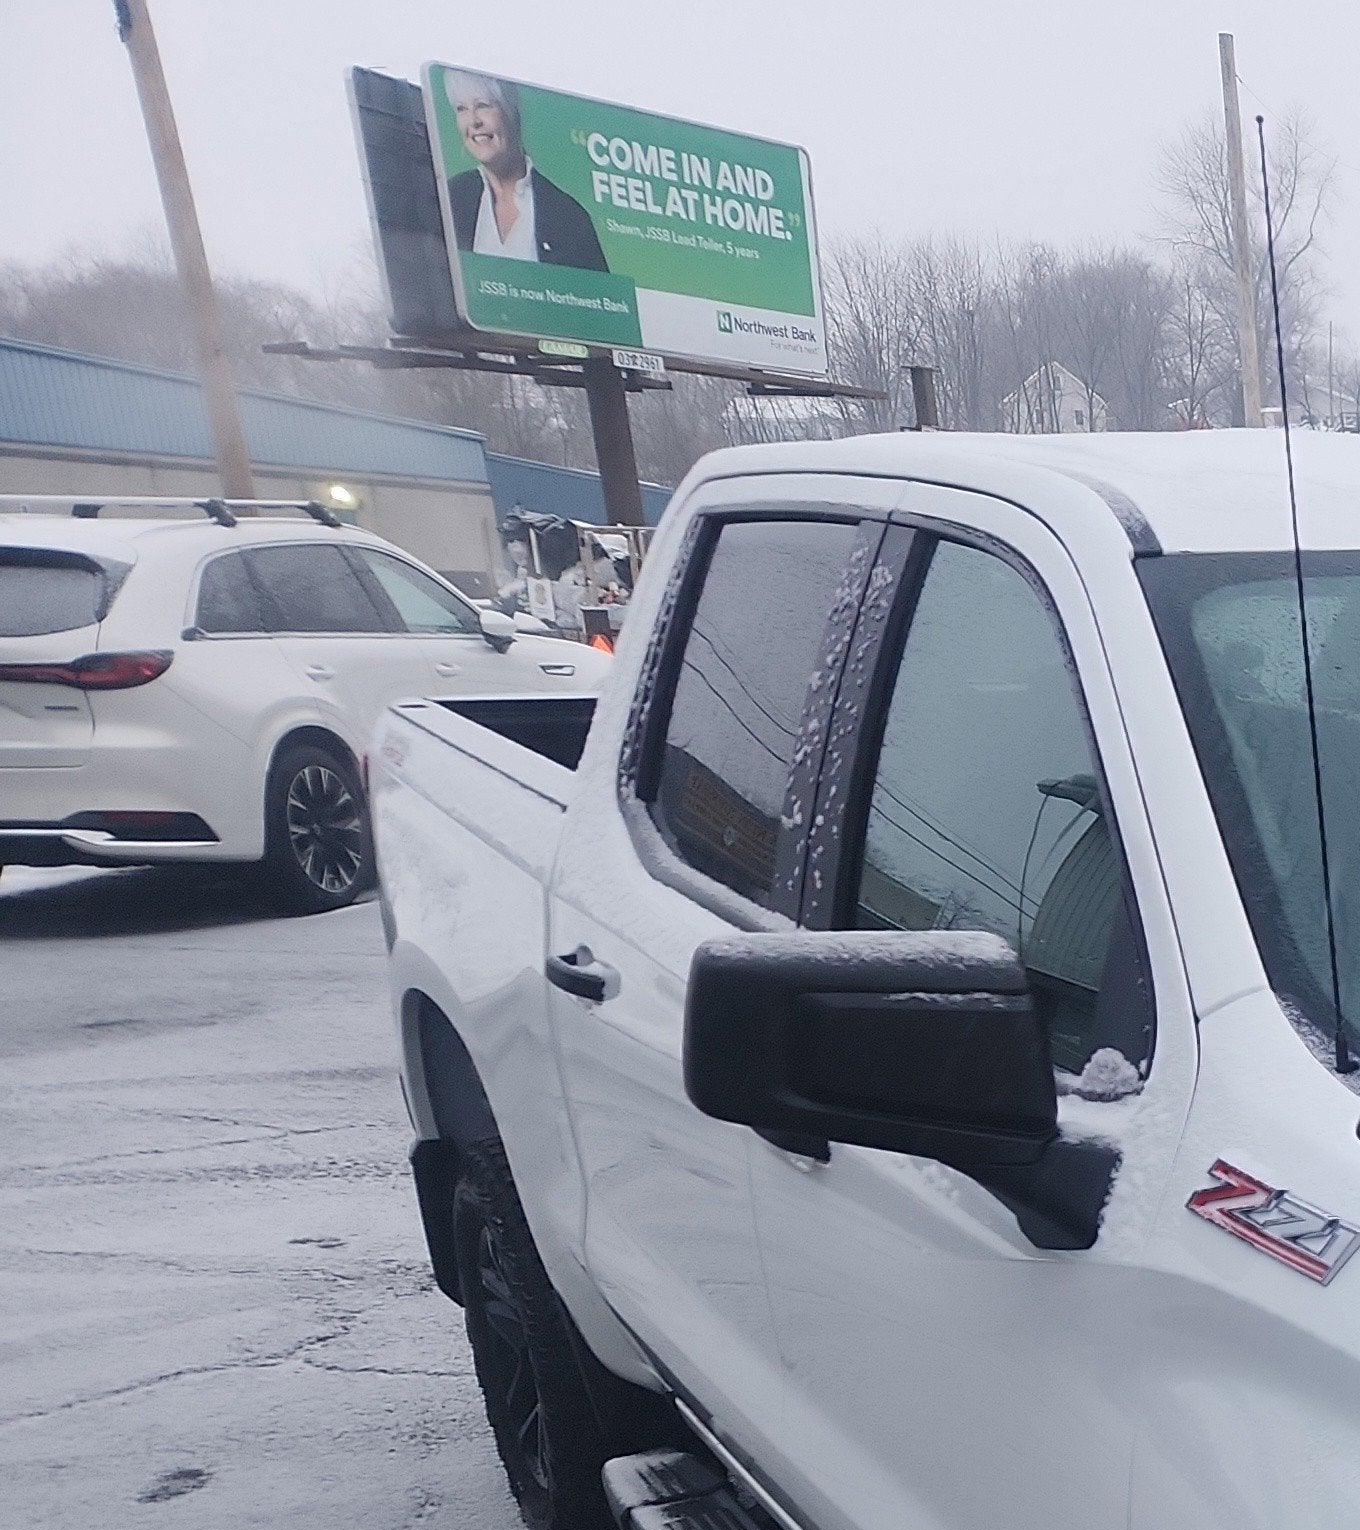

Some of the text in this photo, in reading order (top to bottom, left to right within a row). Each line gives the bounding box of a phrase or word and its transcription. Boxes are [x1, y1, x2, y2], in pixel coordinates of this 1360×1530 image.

[681, 152, 712, 189] IN
[716, 161, 775, 201] AND
[590, 170, 663, 216] FEEL
[665, 186, 700, 222] AT
[672, 229, 696, 247] Lead
[726, 241, 734, 254] 5
[733, 245, 760, 260] years
[478, 280, 630, 314] JSSB is now Northwest Bank
[733, 317, 788, 339] Northwest
[791, 326, 816, 343] Bank
